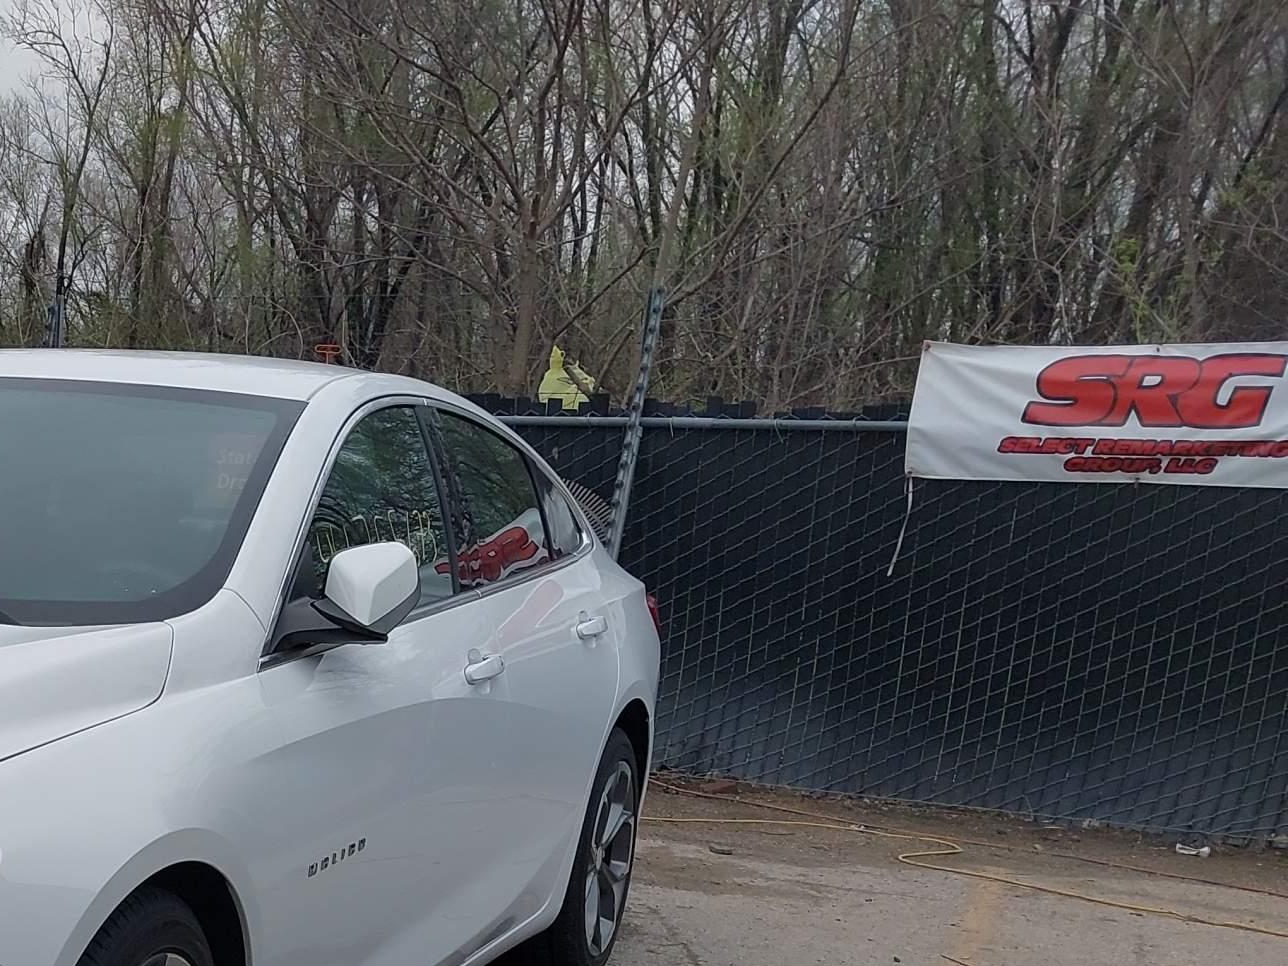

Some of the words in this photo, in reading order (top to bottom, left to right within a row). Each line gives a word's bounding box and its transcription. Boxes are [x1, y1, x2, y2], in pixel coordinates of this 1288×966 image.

[1020, 353, 1288, 429] SRG
[997, 436, 1097, 455] SELECT
[1163, 457, 1219, 475] LLC
